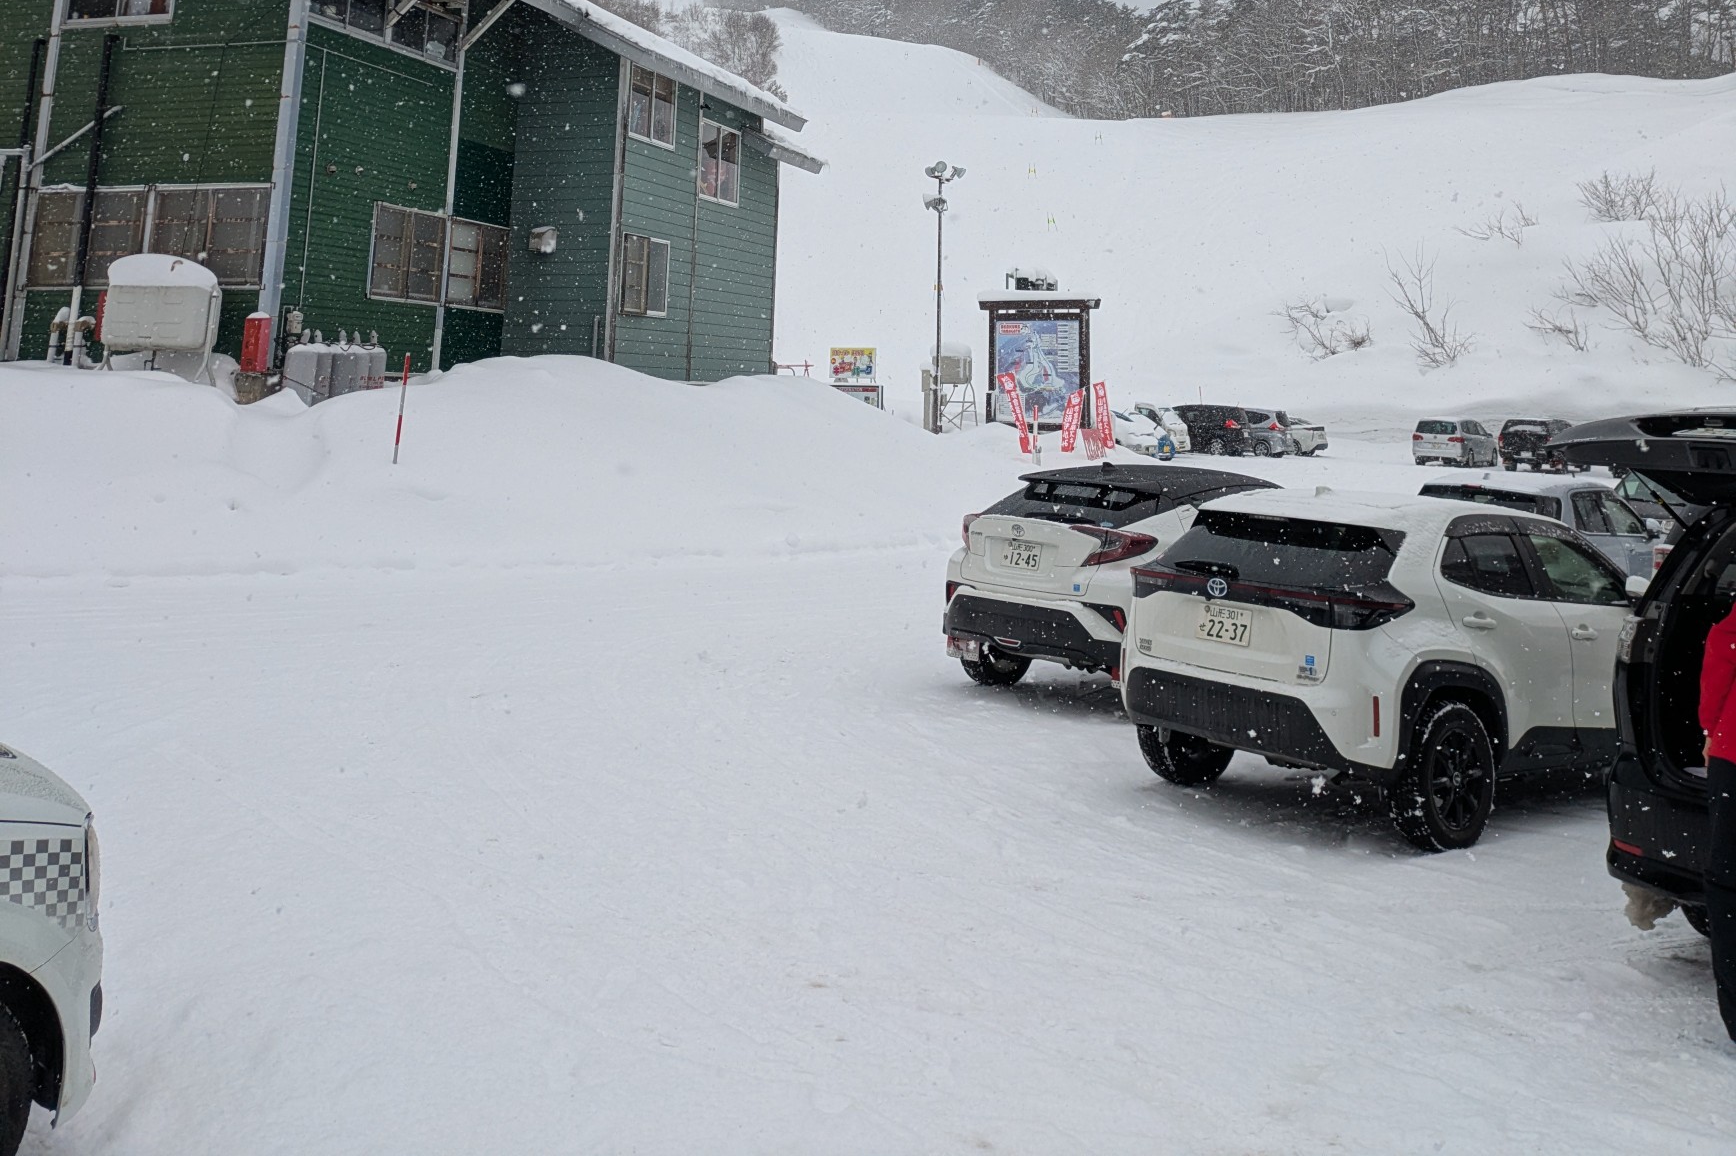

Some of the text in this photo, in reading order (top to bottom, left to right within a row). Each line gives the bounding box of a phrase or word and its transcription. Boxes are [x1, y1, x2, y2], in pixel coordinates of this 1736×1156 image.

[1009, 551, 1038, 567] 12-45
[1210, 607, 1239, 621] 山形 301
[1199, 619, 1248, 642] せ 22-37
